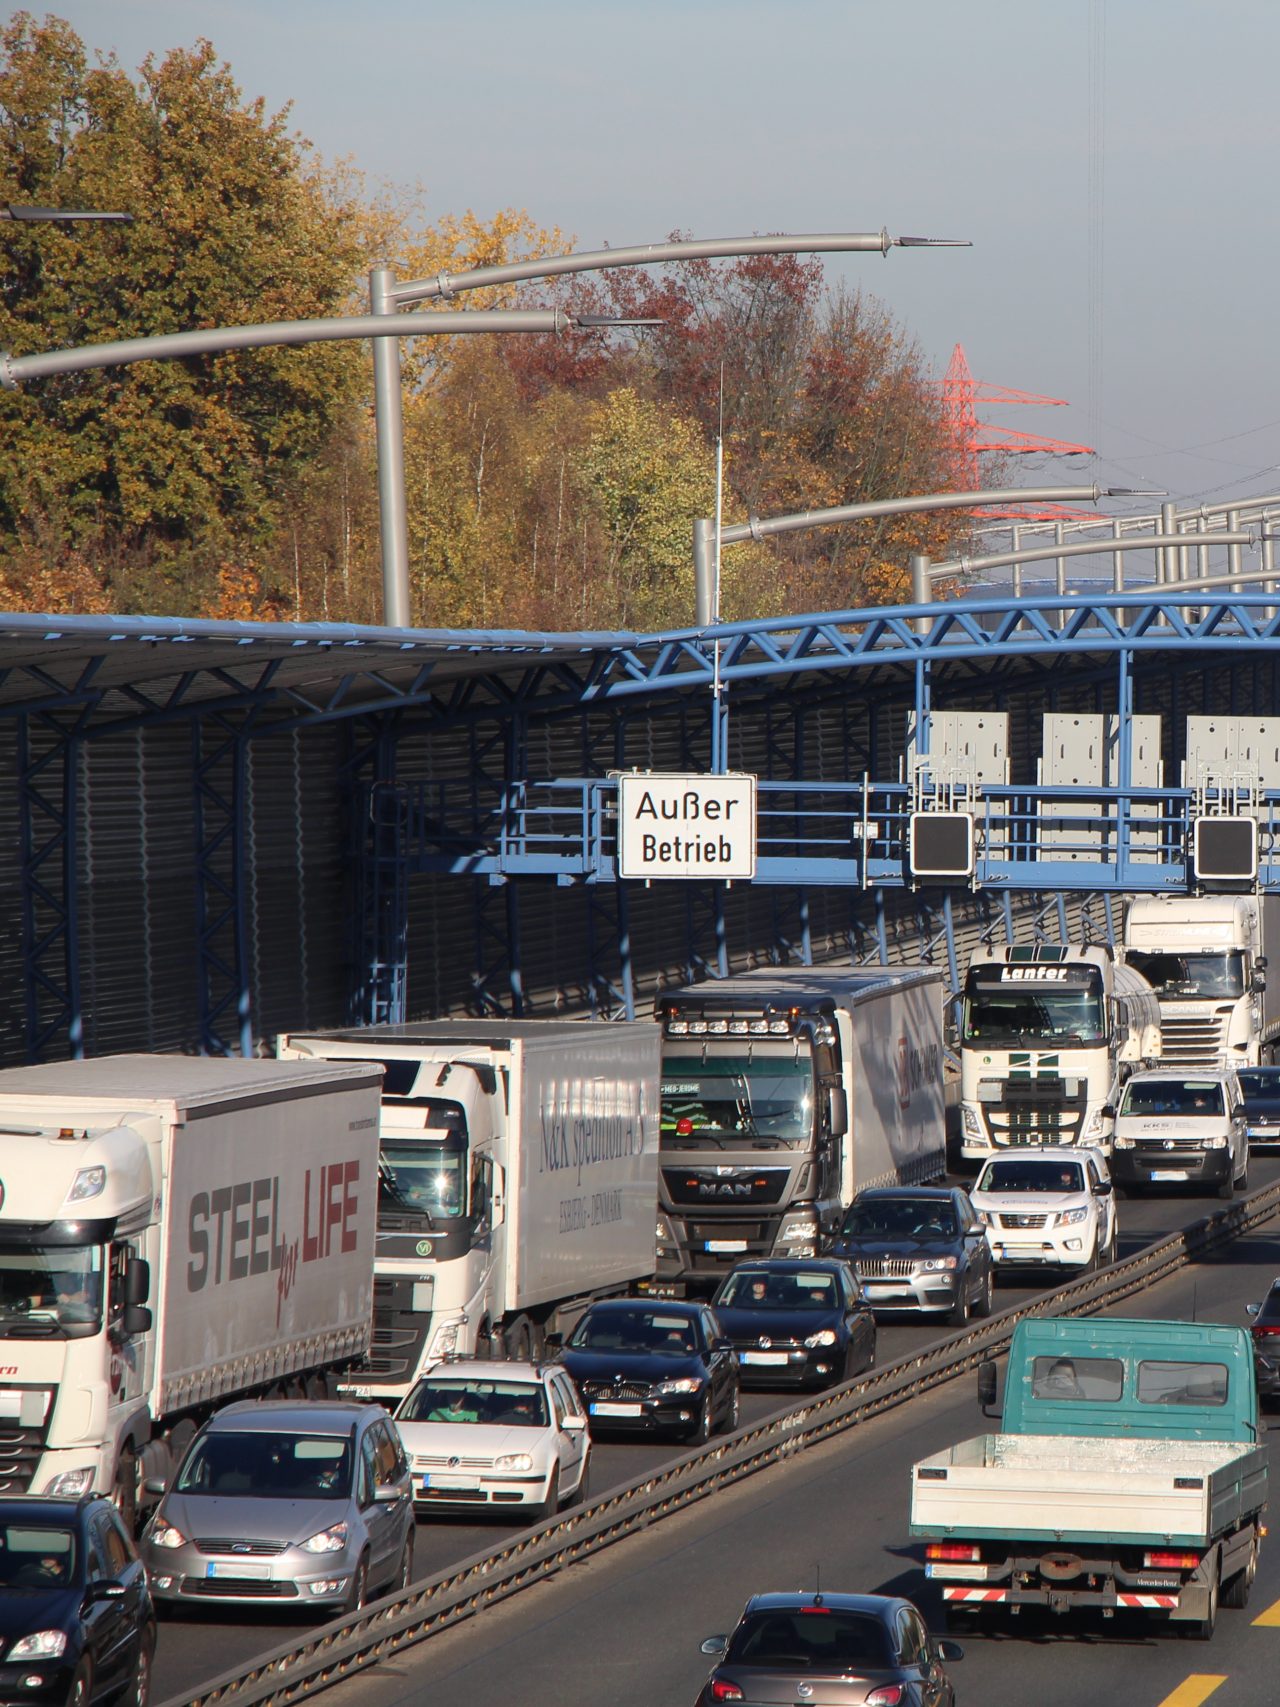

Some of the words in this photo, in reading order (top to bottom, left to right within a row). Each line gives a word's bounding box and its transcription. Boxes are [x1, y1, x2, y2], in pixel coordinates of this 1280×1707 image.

[635, 791, 739, 820] Außer
[642, 834, 732, 862] Betrieb
[1001, 966, 1068, 980] Lanfer
[700, 1184, 752, 1195] MAN
[187, 1176, 288, 1293] STEEL
[301, 1160, 360, 1264] LIFE
[648, 1288, 675, 1296] MAN
